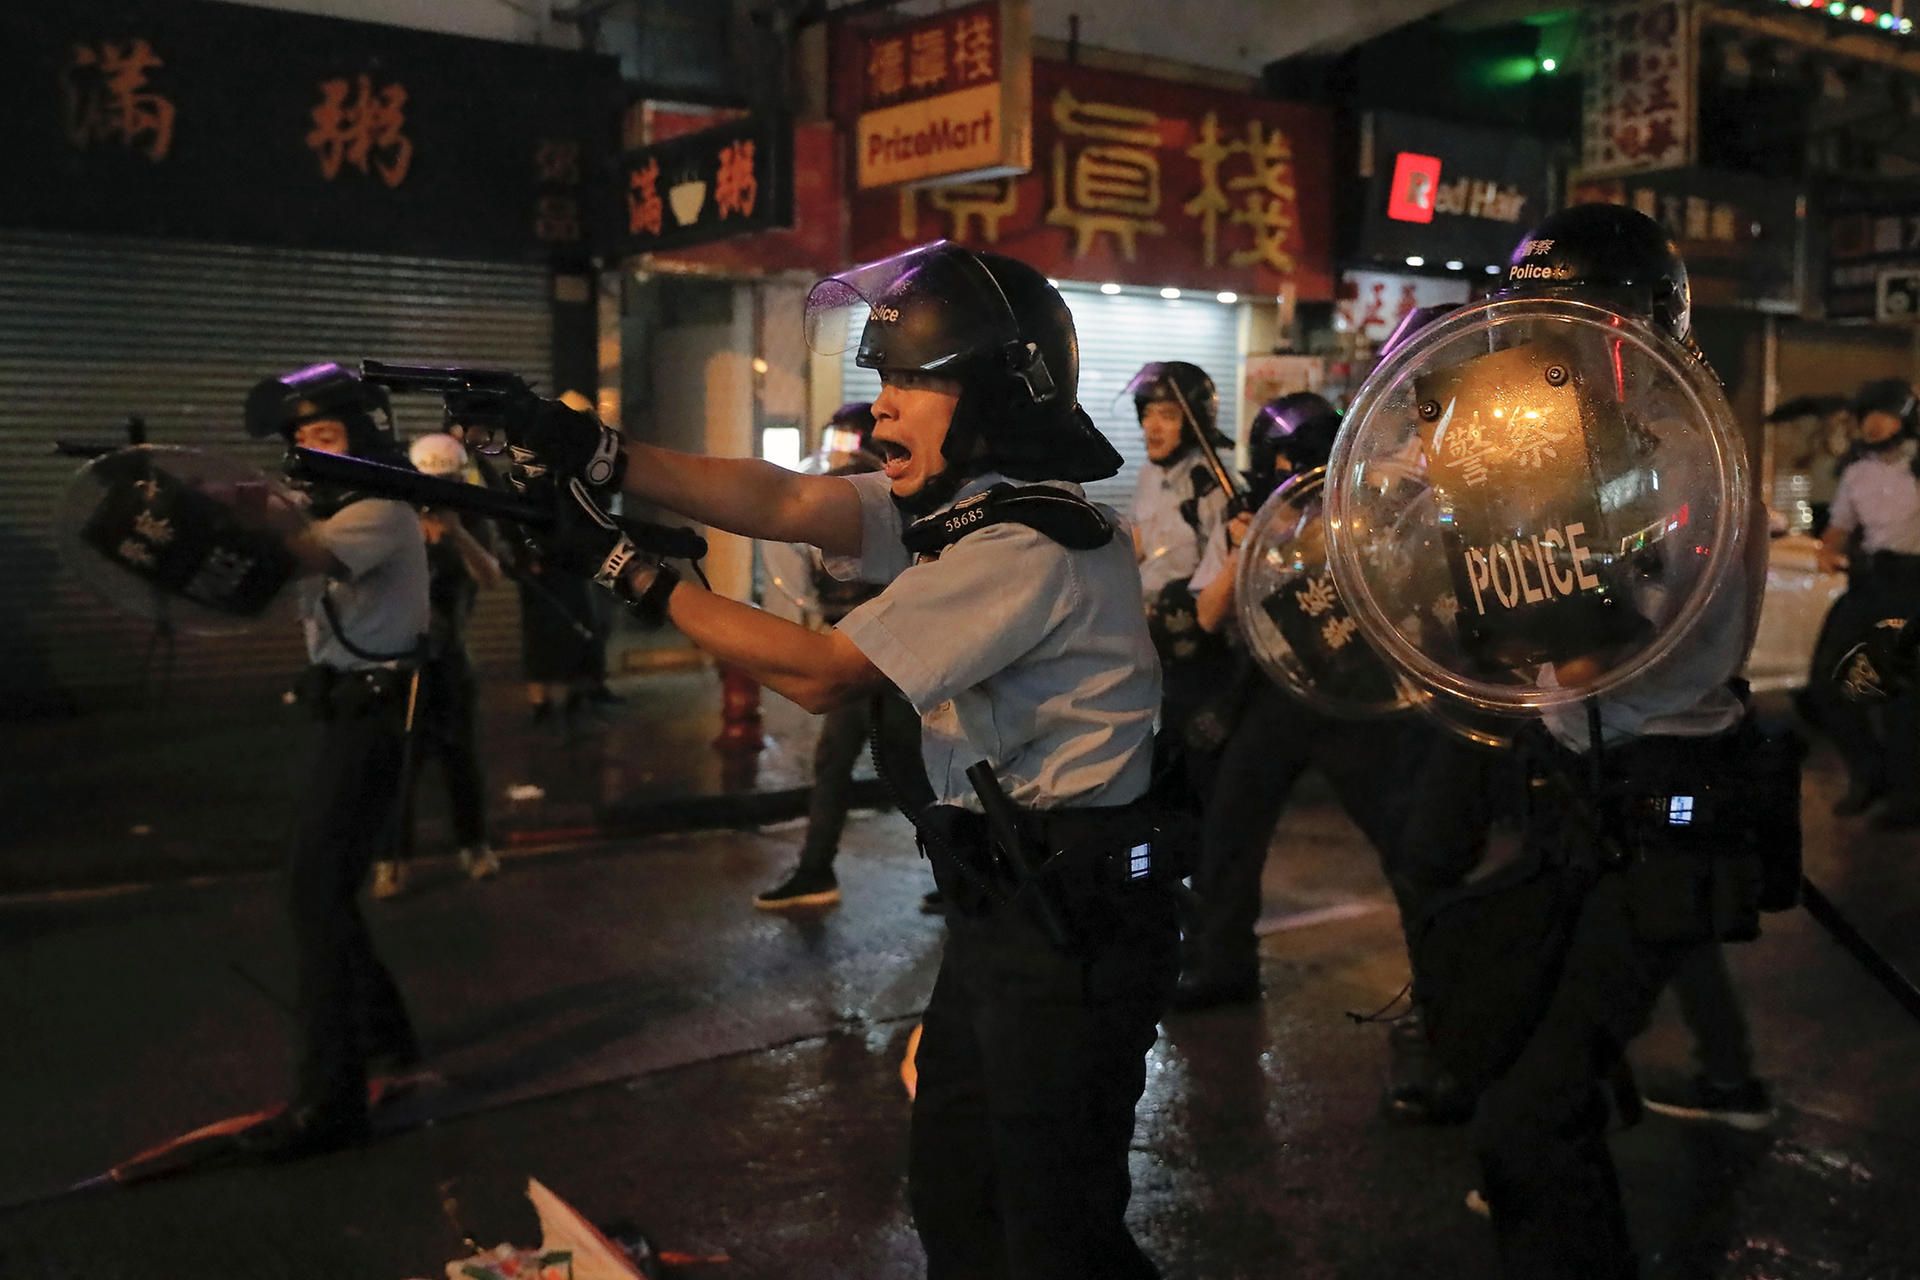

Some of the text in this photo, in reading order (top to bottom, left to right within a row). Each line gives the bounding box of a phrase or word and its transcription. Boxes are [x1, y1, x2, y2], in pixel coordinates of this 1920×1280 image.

[868, 110, 993, 166] PrizeMart
[1508, 263, 1553, 281] Police
[944, 507, 985, 533] 58685
[1464, 521, 1600, 617] POLICE
